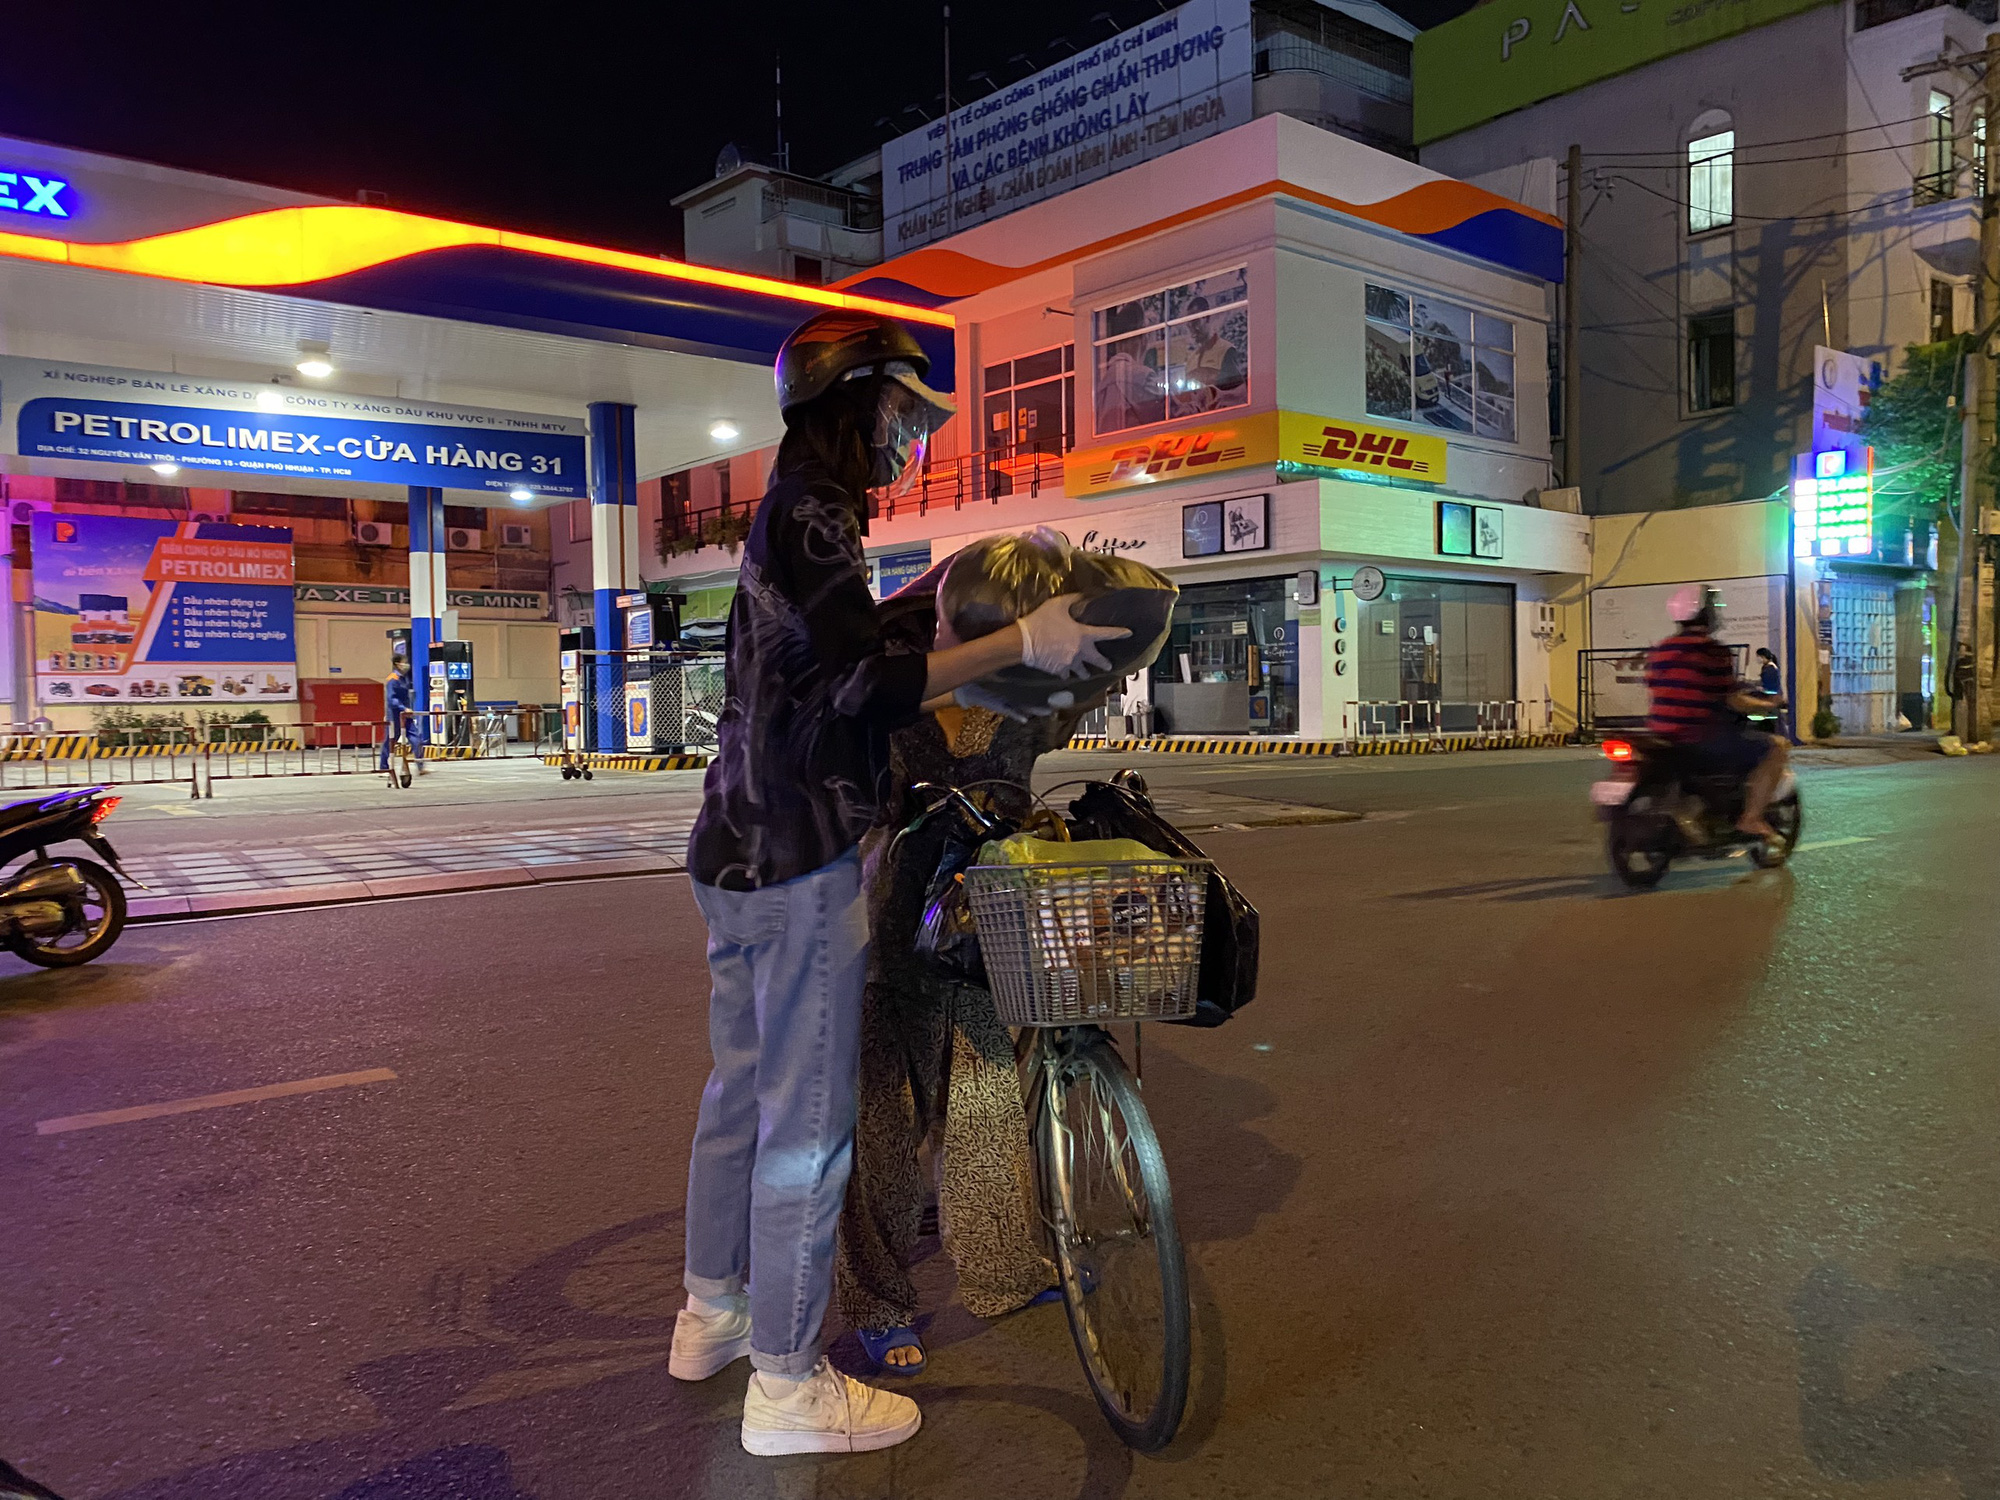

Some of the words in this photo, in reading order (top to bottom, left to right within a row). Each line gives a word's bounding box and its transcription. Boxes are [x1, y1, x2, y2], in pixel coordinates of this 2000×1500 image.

[1037, 62, 1076, 92] THÀNH
[1076, 47, 1102, 74] PHỐ
[1146, 16, 1179, 43] MINH
[897, 150, 943, 184] TRUNG
[976, 111, 1029, 151] PHÒNG
[1031, 83, 1088, 127] CHỐNG
[1090, 58, 1139, 101] CHẤN
[1140, 25, 1225, 78] THƯƠNG
[952, 163, 972, 193] VÀ
[973, 150, 1005, 183] CÁC
[1053, 108, 1112, 149] KHÔNG
[1115, 91, 1150, 125] LÂY
[63, 372, 128, 388] NGHIỆP
[131, 377, 167, 392] BÁN
[285, 395, 329, 408] CÔNG
[331, 401, 350, 410] TY
[426, 410, 454, 421] KHU
[456, 412, 485, 424] VỰC
[505, 418, 539, 430] TNHH
[541, 422, 567, 433] MTV
[132, 452, 152, 460] VĂN
[181, 456, 222, 466] PHƯỜNG
[239, 461, 265, 470] QUẬN
[284, 464, 315, 474] NHUẬN
[333, 468, 352, 476] HCM
[425, 443, 524, 472] HÀNG
[530, 455, 563, 476] 31
[1108, 432, 1224, 482] DHL
[1319, 425, 1414, 471] DHL
[160, 559, 287, 579] PETROLIMEX
[334, 588, 371, 603] XE
[483, 594, 541, 609] MINH
